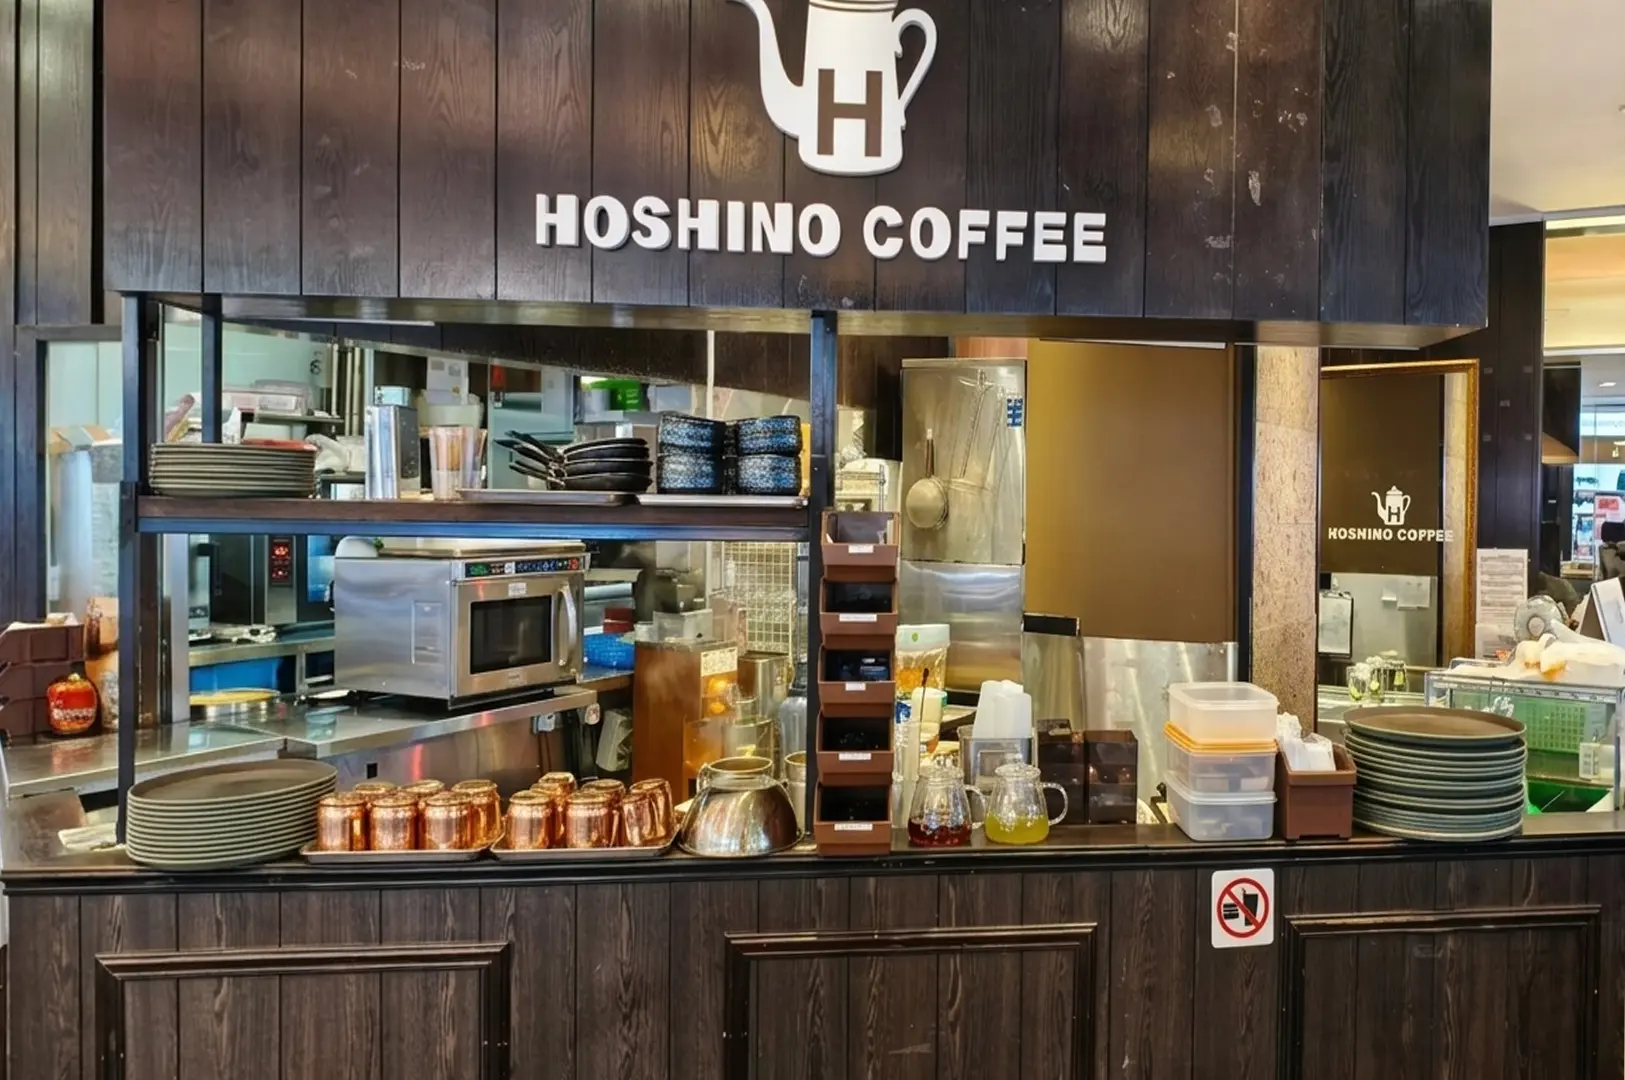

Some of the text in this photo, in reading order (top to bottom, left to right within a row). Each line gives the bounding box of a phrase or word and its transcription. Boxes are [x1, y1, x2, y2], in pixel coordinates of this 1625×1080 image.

[817, 68, 883, 158] H
[535, 193, 1107, 263] HOSHINO COFFEE
